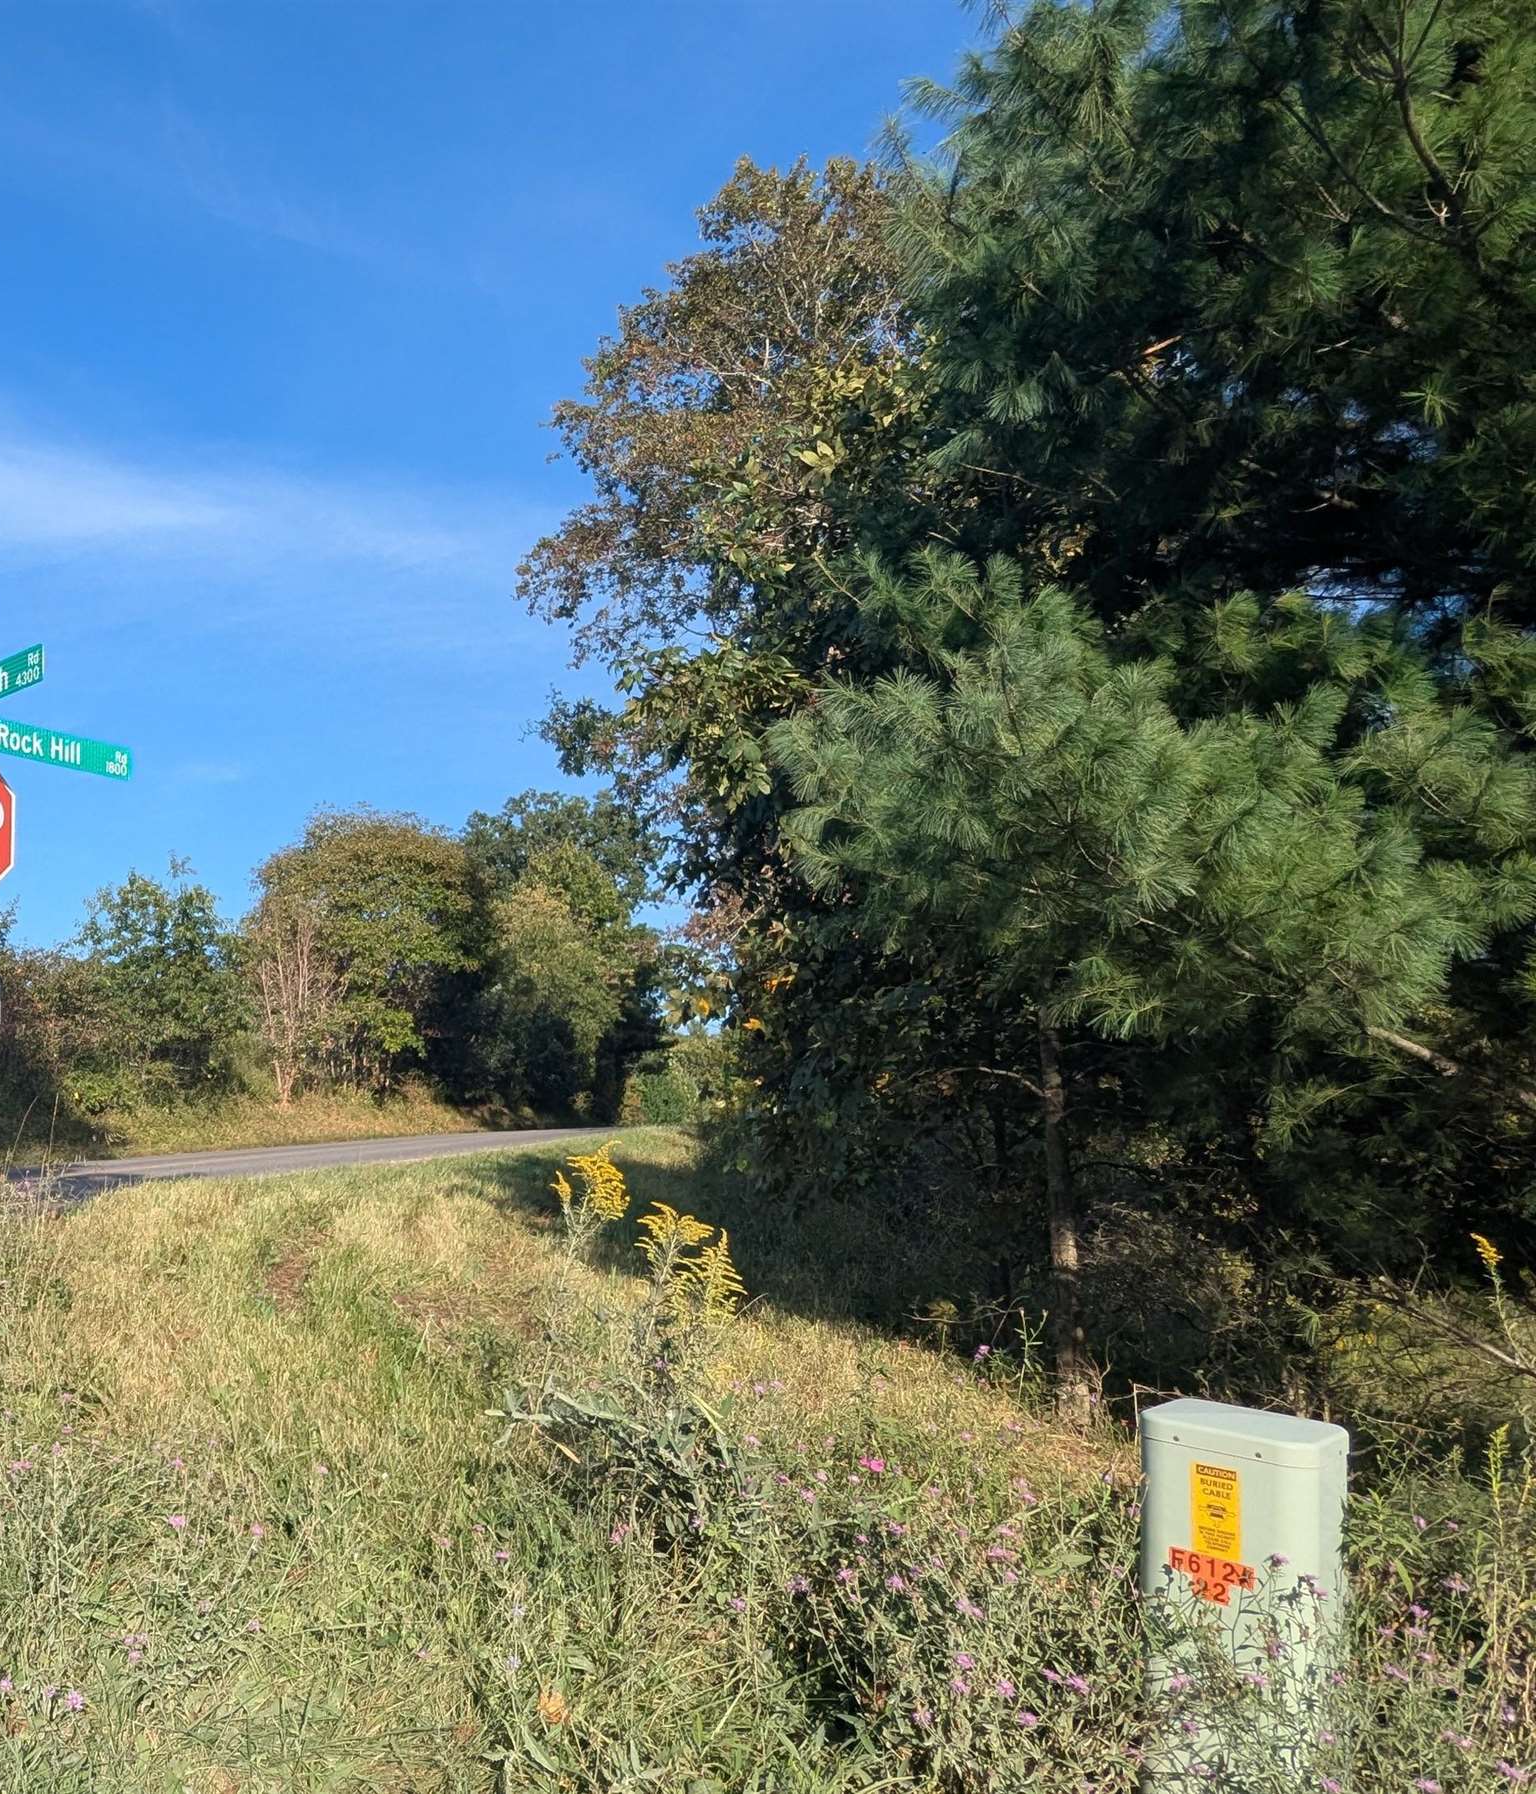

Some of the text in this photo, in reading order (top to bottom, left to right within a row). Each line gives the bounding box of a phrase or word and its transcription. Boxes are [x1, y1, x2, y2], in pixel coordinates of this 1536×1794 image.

[27, 651, 40, 667] Rd
[15, 666, 40, 687] 4300
[50, 738, 81, 765] Hill
[115, 750, 128, 764] Rd
[1197, 1465, 1236, 1480] CAUTION
[1200, 1477, 1233, 1491] BURIED
[1202, 1488, 1231, 1500] CABLE
